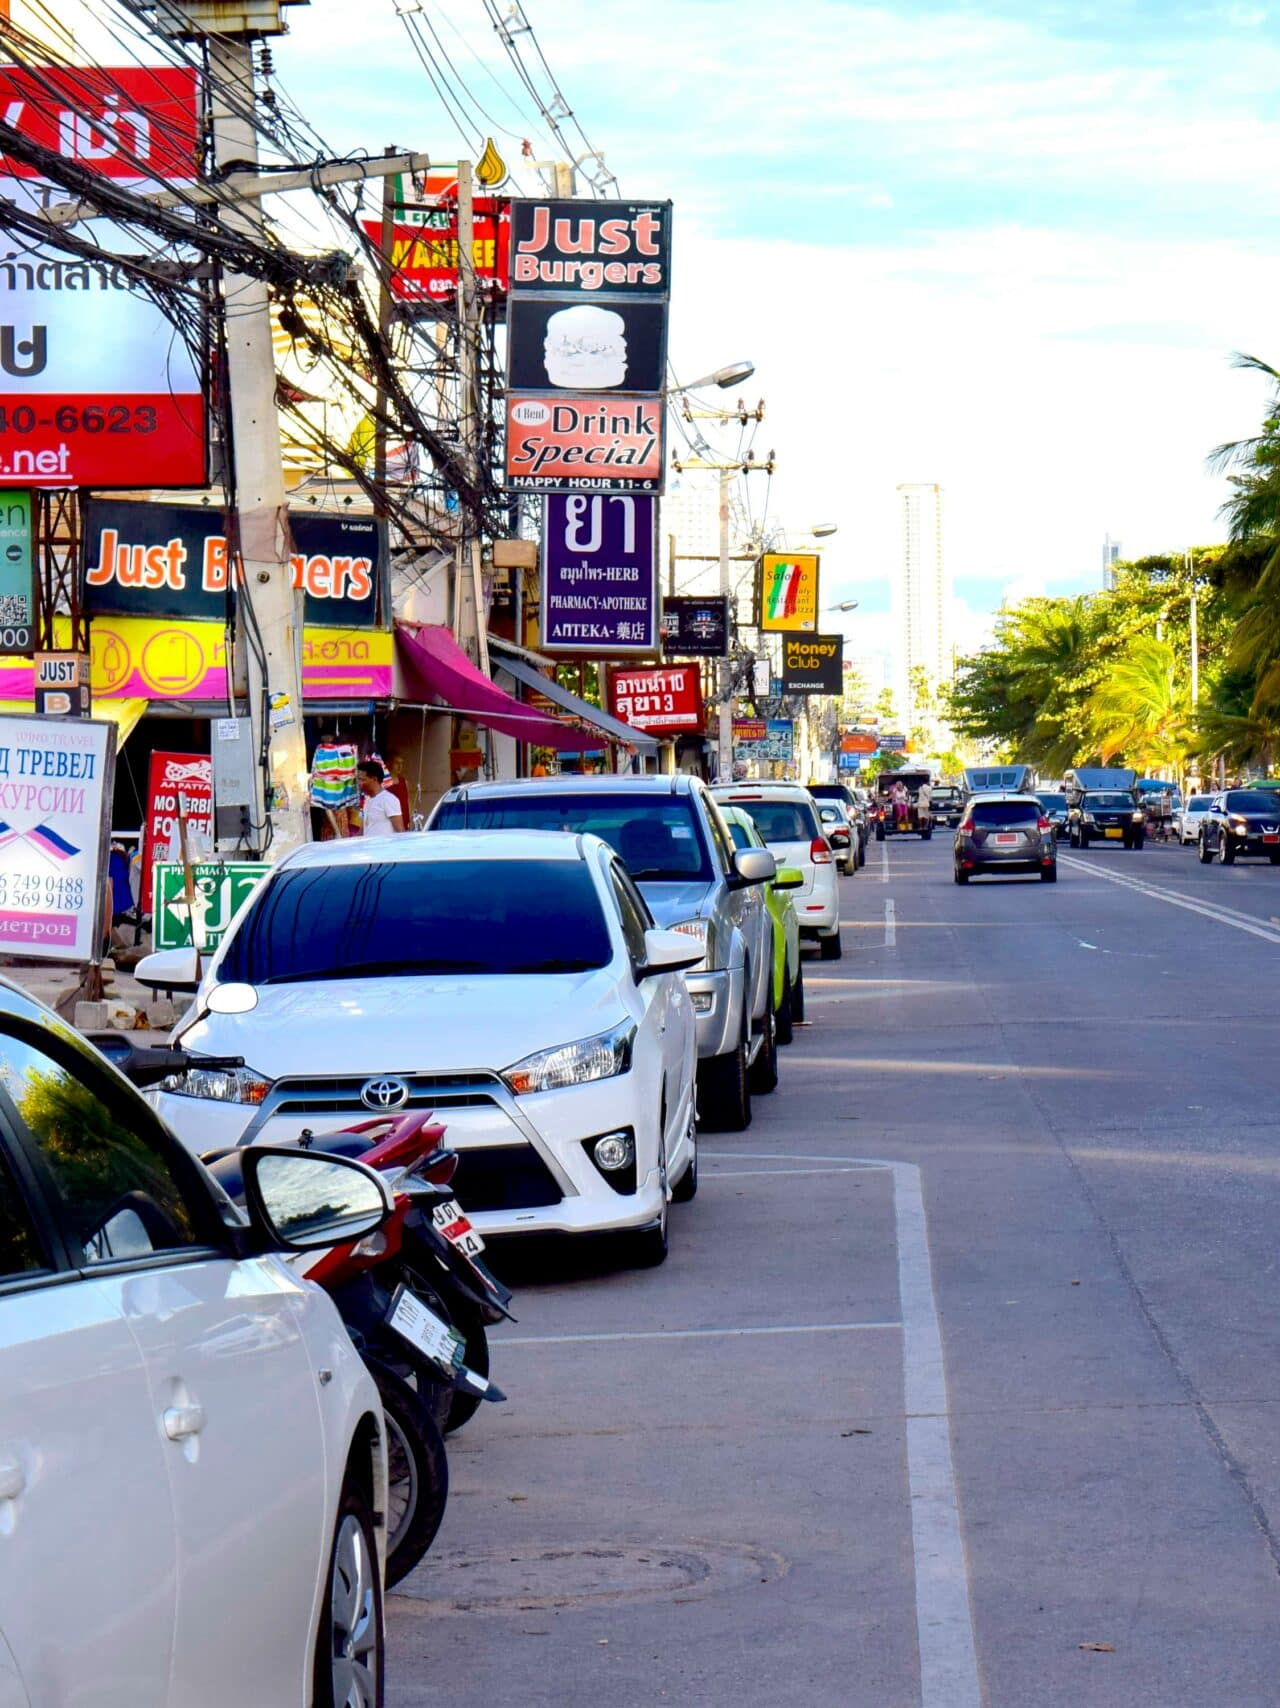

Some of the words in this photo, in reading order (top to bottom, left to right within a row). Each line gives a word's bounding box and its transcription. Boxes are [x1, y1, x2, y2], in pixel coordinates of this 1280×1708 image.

[518, 207, 661, 255] Just
[515, 254, 661, 290] Burgers
[552, 405, 655, 434] Drink
[0, 443, 70, 473] .net
[513, 437, 656, 473] Special
[514, 476, 562, 489] HAPPY
[568, 478, 611, 489] HOUR
[565, 495, 636, 553] ยา
[87, 530, 187, 589] Just
[0, 629, 28, 646] 00
[787, 642, 836, 657] Money
[40, 661, 75, 682] JUST
[787, 656, 820, 669] Club
[669, 673, 684, 691] 10
[44, 692, 71, 714] B
[664, 694, 673, 711] 3
[17, 748, 96, 780] ТРЕВЕЛ
[153, 795, 212, 814] MOERBI
[13, 874, 41, 891] 749
[45, 876, 83, 895] 0488
[12, 895, 41, 909] 569
[45, 898, 84, 913] 9189
